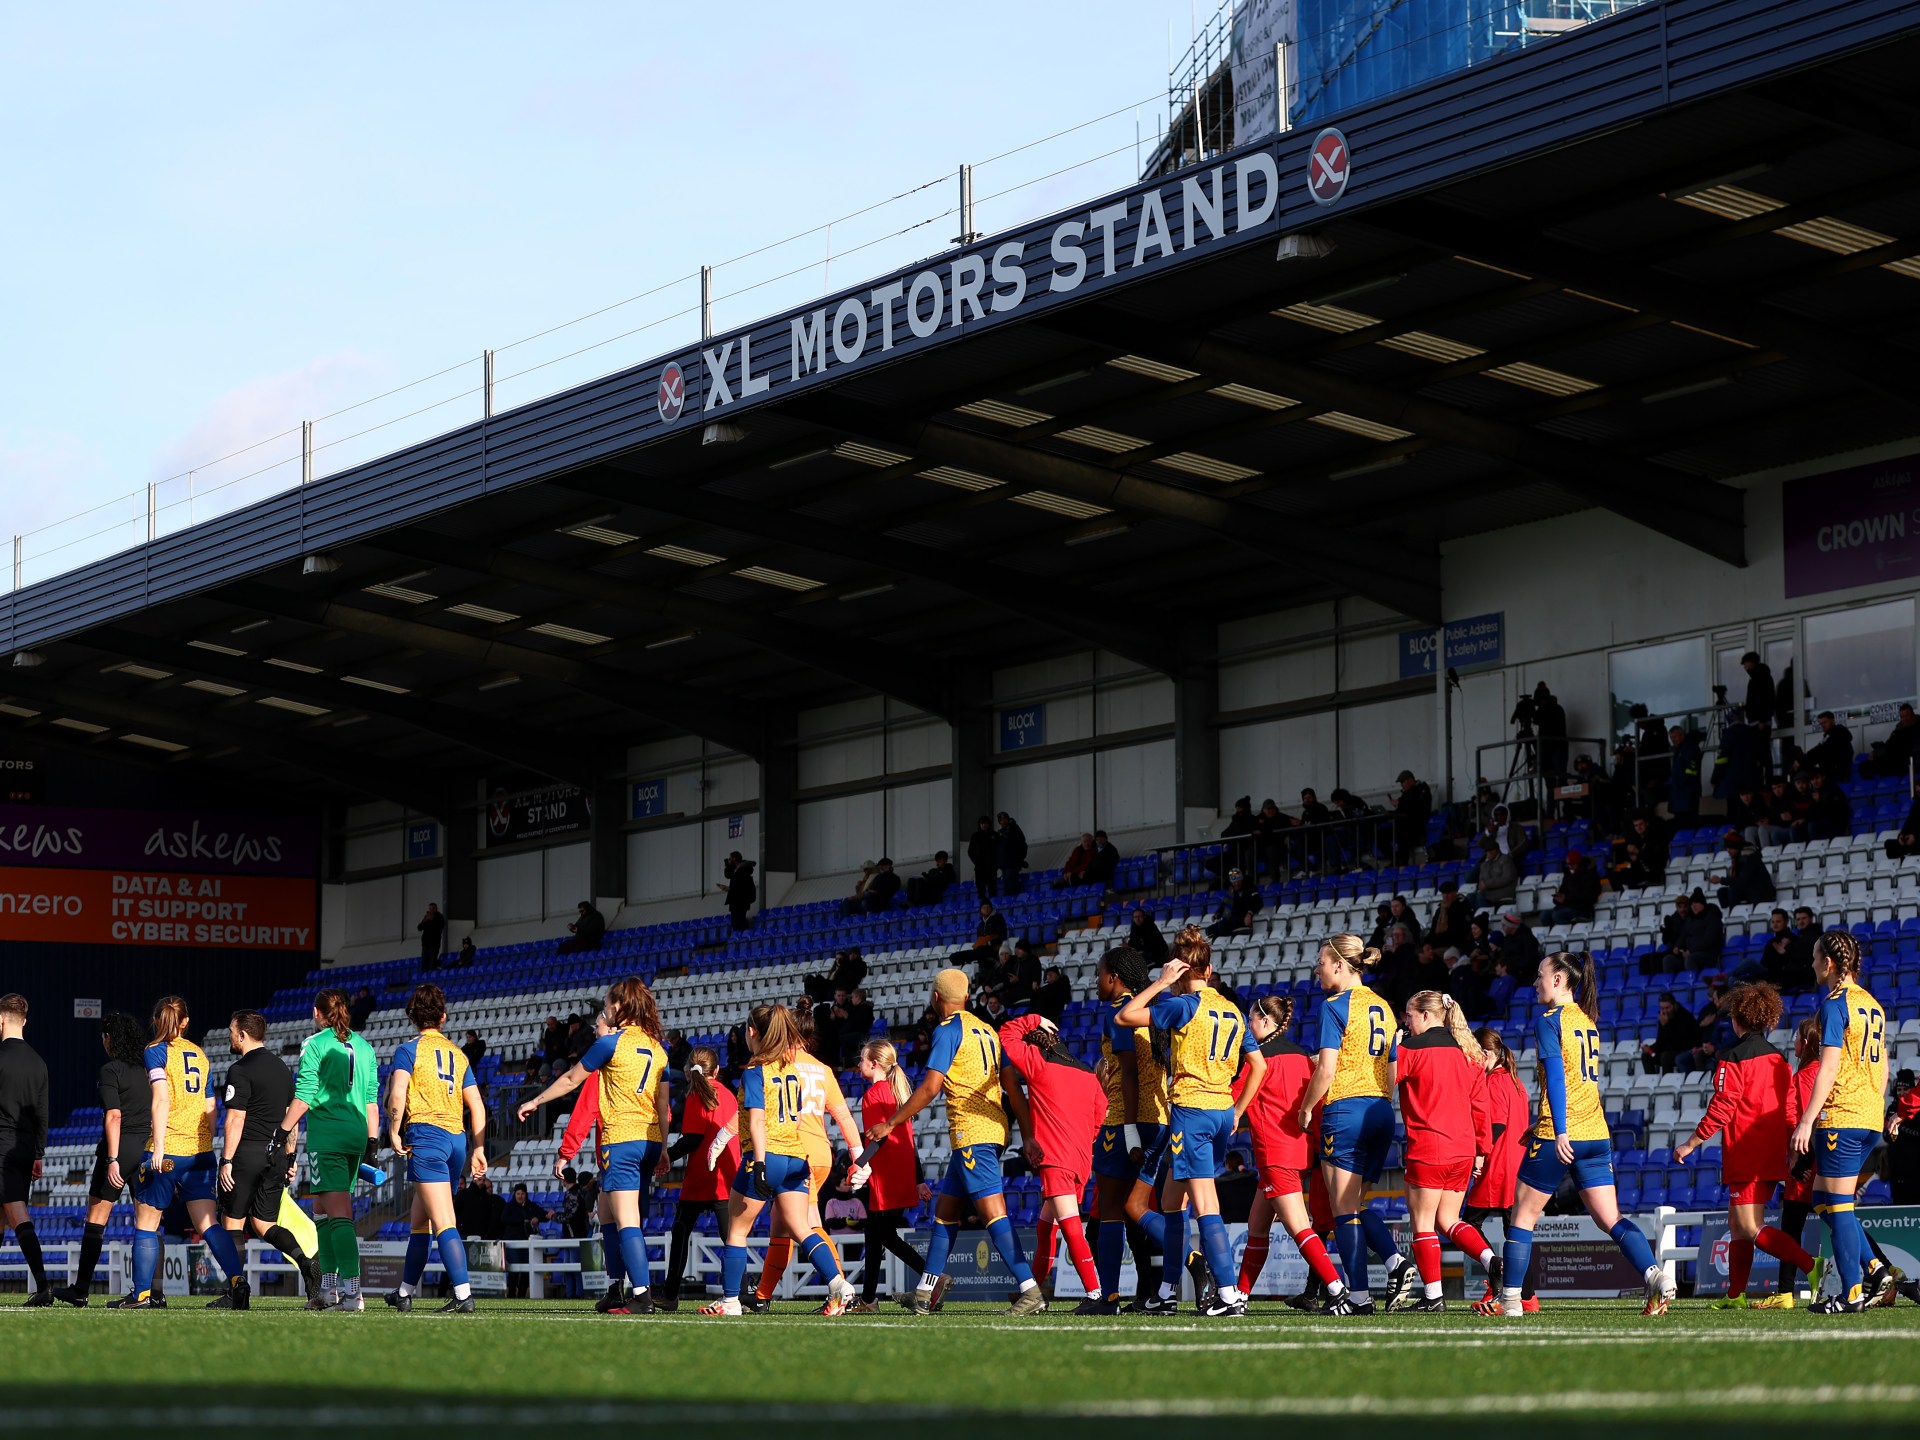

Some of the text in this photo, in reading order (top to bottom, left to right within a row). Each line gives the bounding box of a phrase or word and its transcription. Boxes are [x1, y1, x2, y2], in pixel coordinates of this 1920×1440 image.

[703, 152, 1280, 412] XL MOTORS STAND
[1817, 512, 1905, 552] CROWN
[1446, 622, 1499, 641] Public Address
[1409, 635, 1438, 655] BLOC
[1454, 641, 1477, 656] Safety
[1479, 638, 1499, 652] Point
[1423, 654, 1431, 671] 4
[1008, 712, 1035, 731] BLOCK
[1019, 731, 1025, 745] 3
[638, 785, 659, 801] BLOCK
[528, 802, 567, 824] STAND
[645, 801, 651, 814] 2
[143, 819, 282, 866] askews
[413, 830, 431, 843] BLOCK
[420, 844, 425, 856] 1
[112, 876, 222, 898] DATA & AI
[112, 899, 248, 922] IT SUPPORT
[112, 922, 310, 946] CYBER SECURITY
[1208, 1010, 1239, 1062] 17
[1368, 1005, 1385, 1057] 6
[1857, 1008, 1884, 1062] 13
[971, 1028, 1000, 1077] 11
[1574, 1029, 1599, 1082] 15
[182, 1051, 200, 1094] 5
[343, 1042, 356, 1087] 1
[434, 1049, 455, 1095] 4
[636, 1047, 653, 1094] 7
[771, 1074, 803, 1123] 10
[799, 1071, 826, 1117] 25
[1533, 1222, 1580, 1232] ENCHMARX
[947, 1252, 974, 1263] VENTRY'S
[1539, 1244, 1550, 1253] Your
[1551, 1244, 1563, 1253] local
[1563, 1244, 1576, 1253] trade
[1577, 1244, 1594, 1253] kitchen
[1595, 1244, 1605, 1253] and
